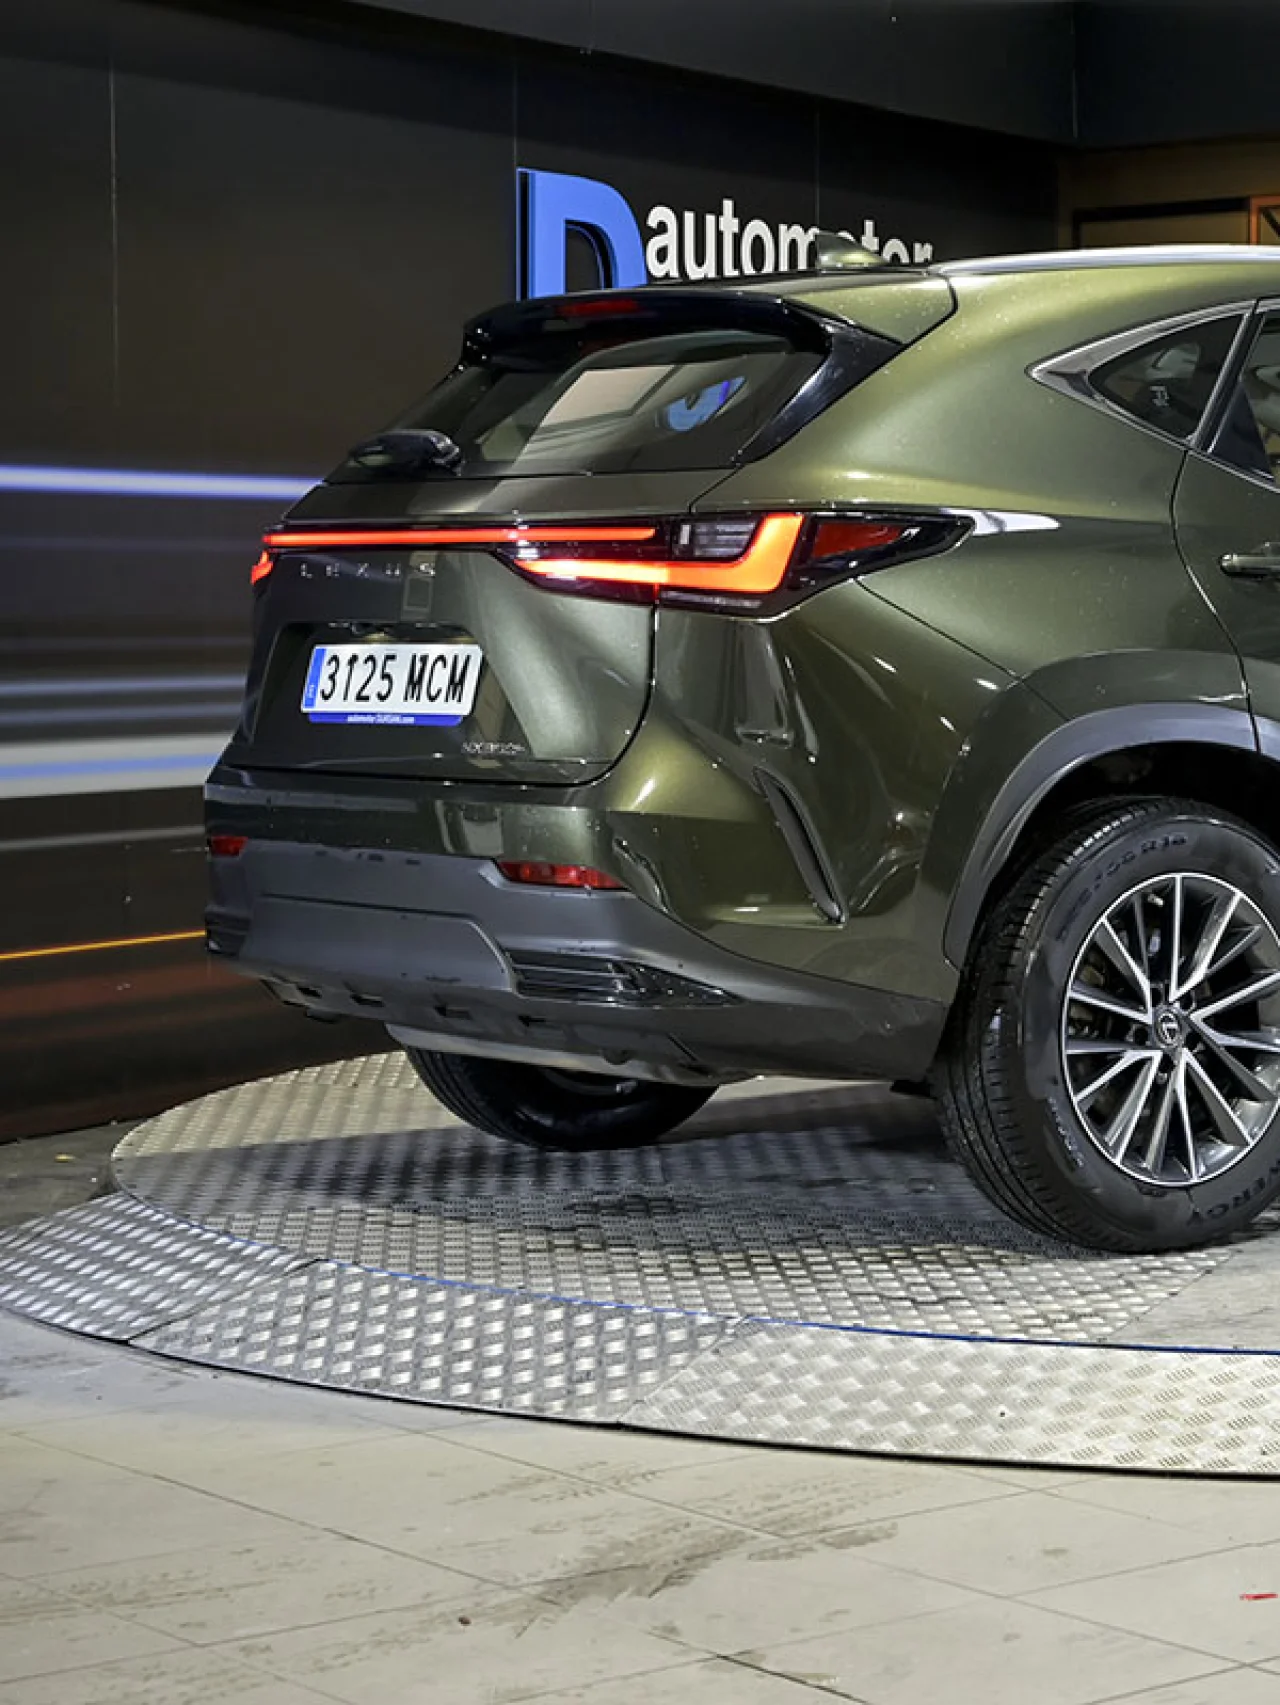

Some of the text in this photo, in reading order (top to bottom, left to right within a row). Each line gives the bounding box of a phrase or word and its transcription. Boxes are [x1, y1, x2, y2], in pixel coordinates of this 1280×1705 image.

[645, 198, 933, 281] automt
[320, 653, 472, 703] 3125 MCM
